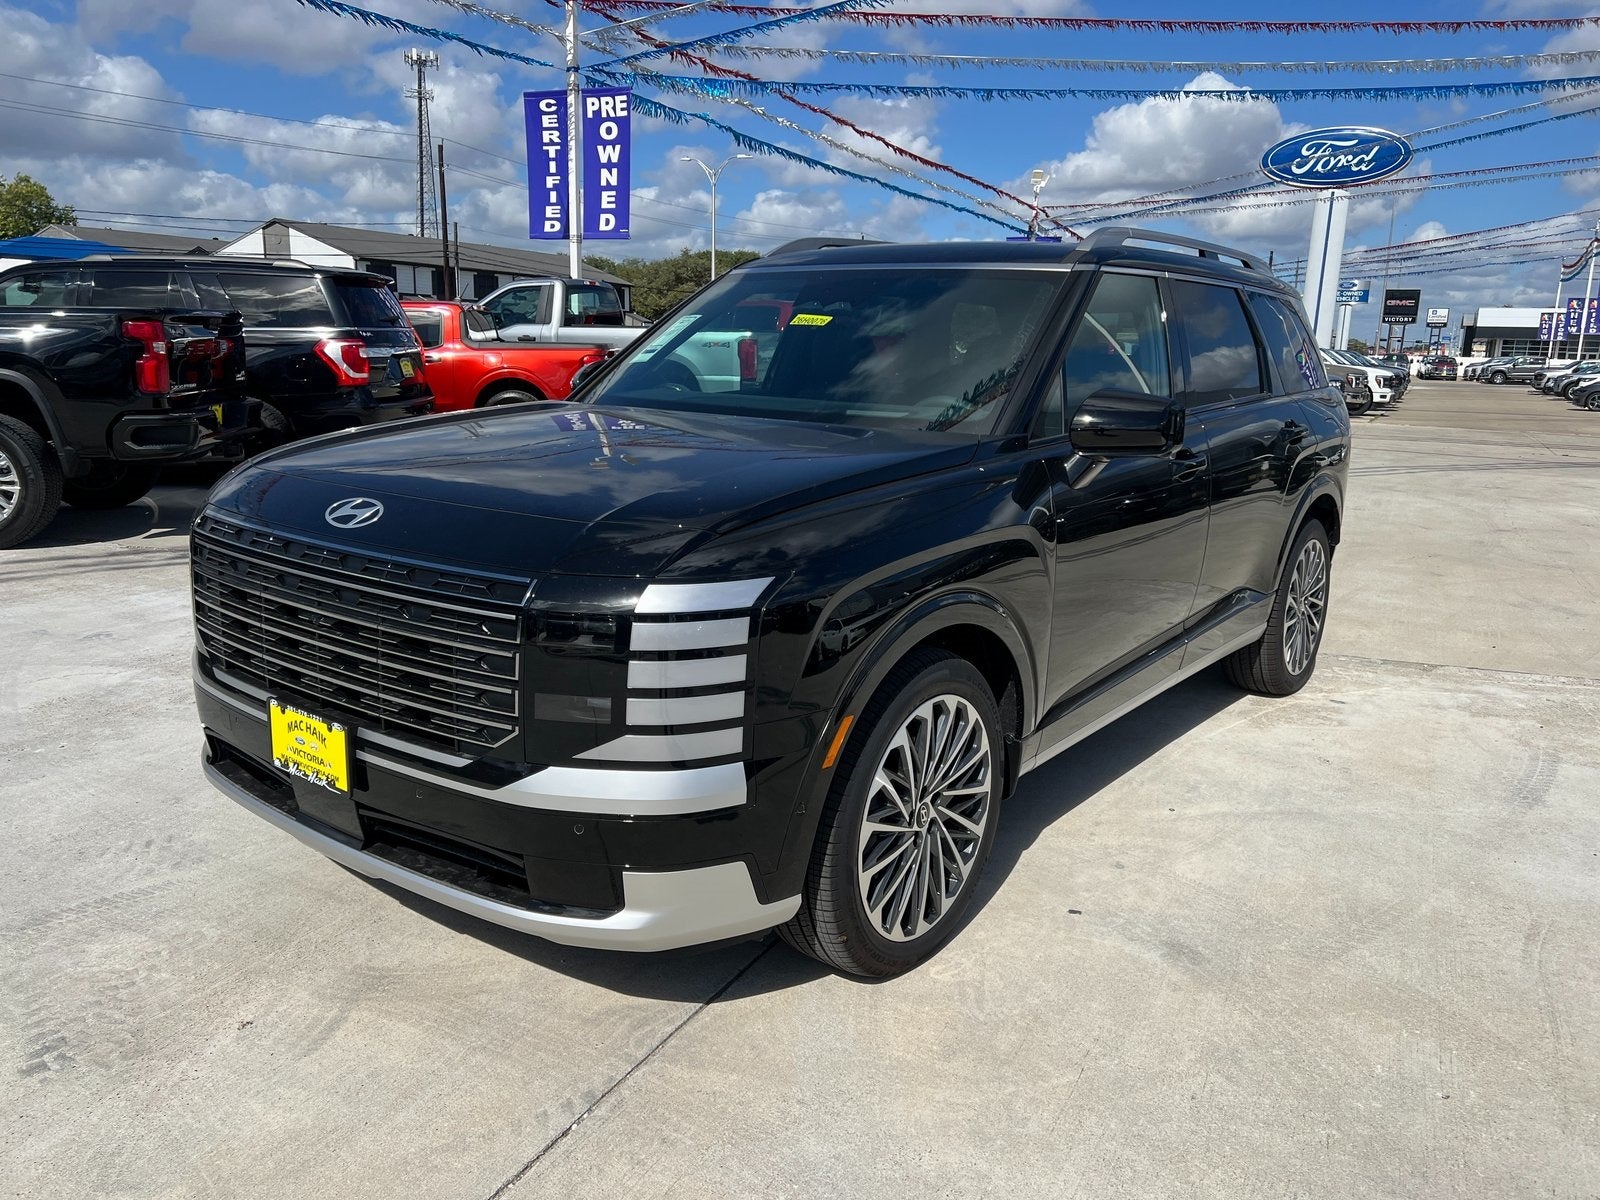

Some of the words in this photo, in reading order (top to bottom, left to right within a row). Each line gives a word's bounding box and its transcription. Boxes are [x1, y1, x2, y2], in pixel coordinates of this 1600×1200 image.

[586, 95, 628, 118] PRE
[539, 98, 562, 233] CERTIFIED
[1291, 139, 1380, 175] Ford
[597, 121, 621, 231] OWNED
[1568, 312, 1578, 333] NEW
[287, 720, 304, 735] MAC
[305, 721, 328, 749] HAIK
[291, 746, 326, 768] VICTORIA
[287, 763, 307, 780] Mac
[307, 771, 329, 787] Haik
